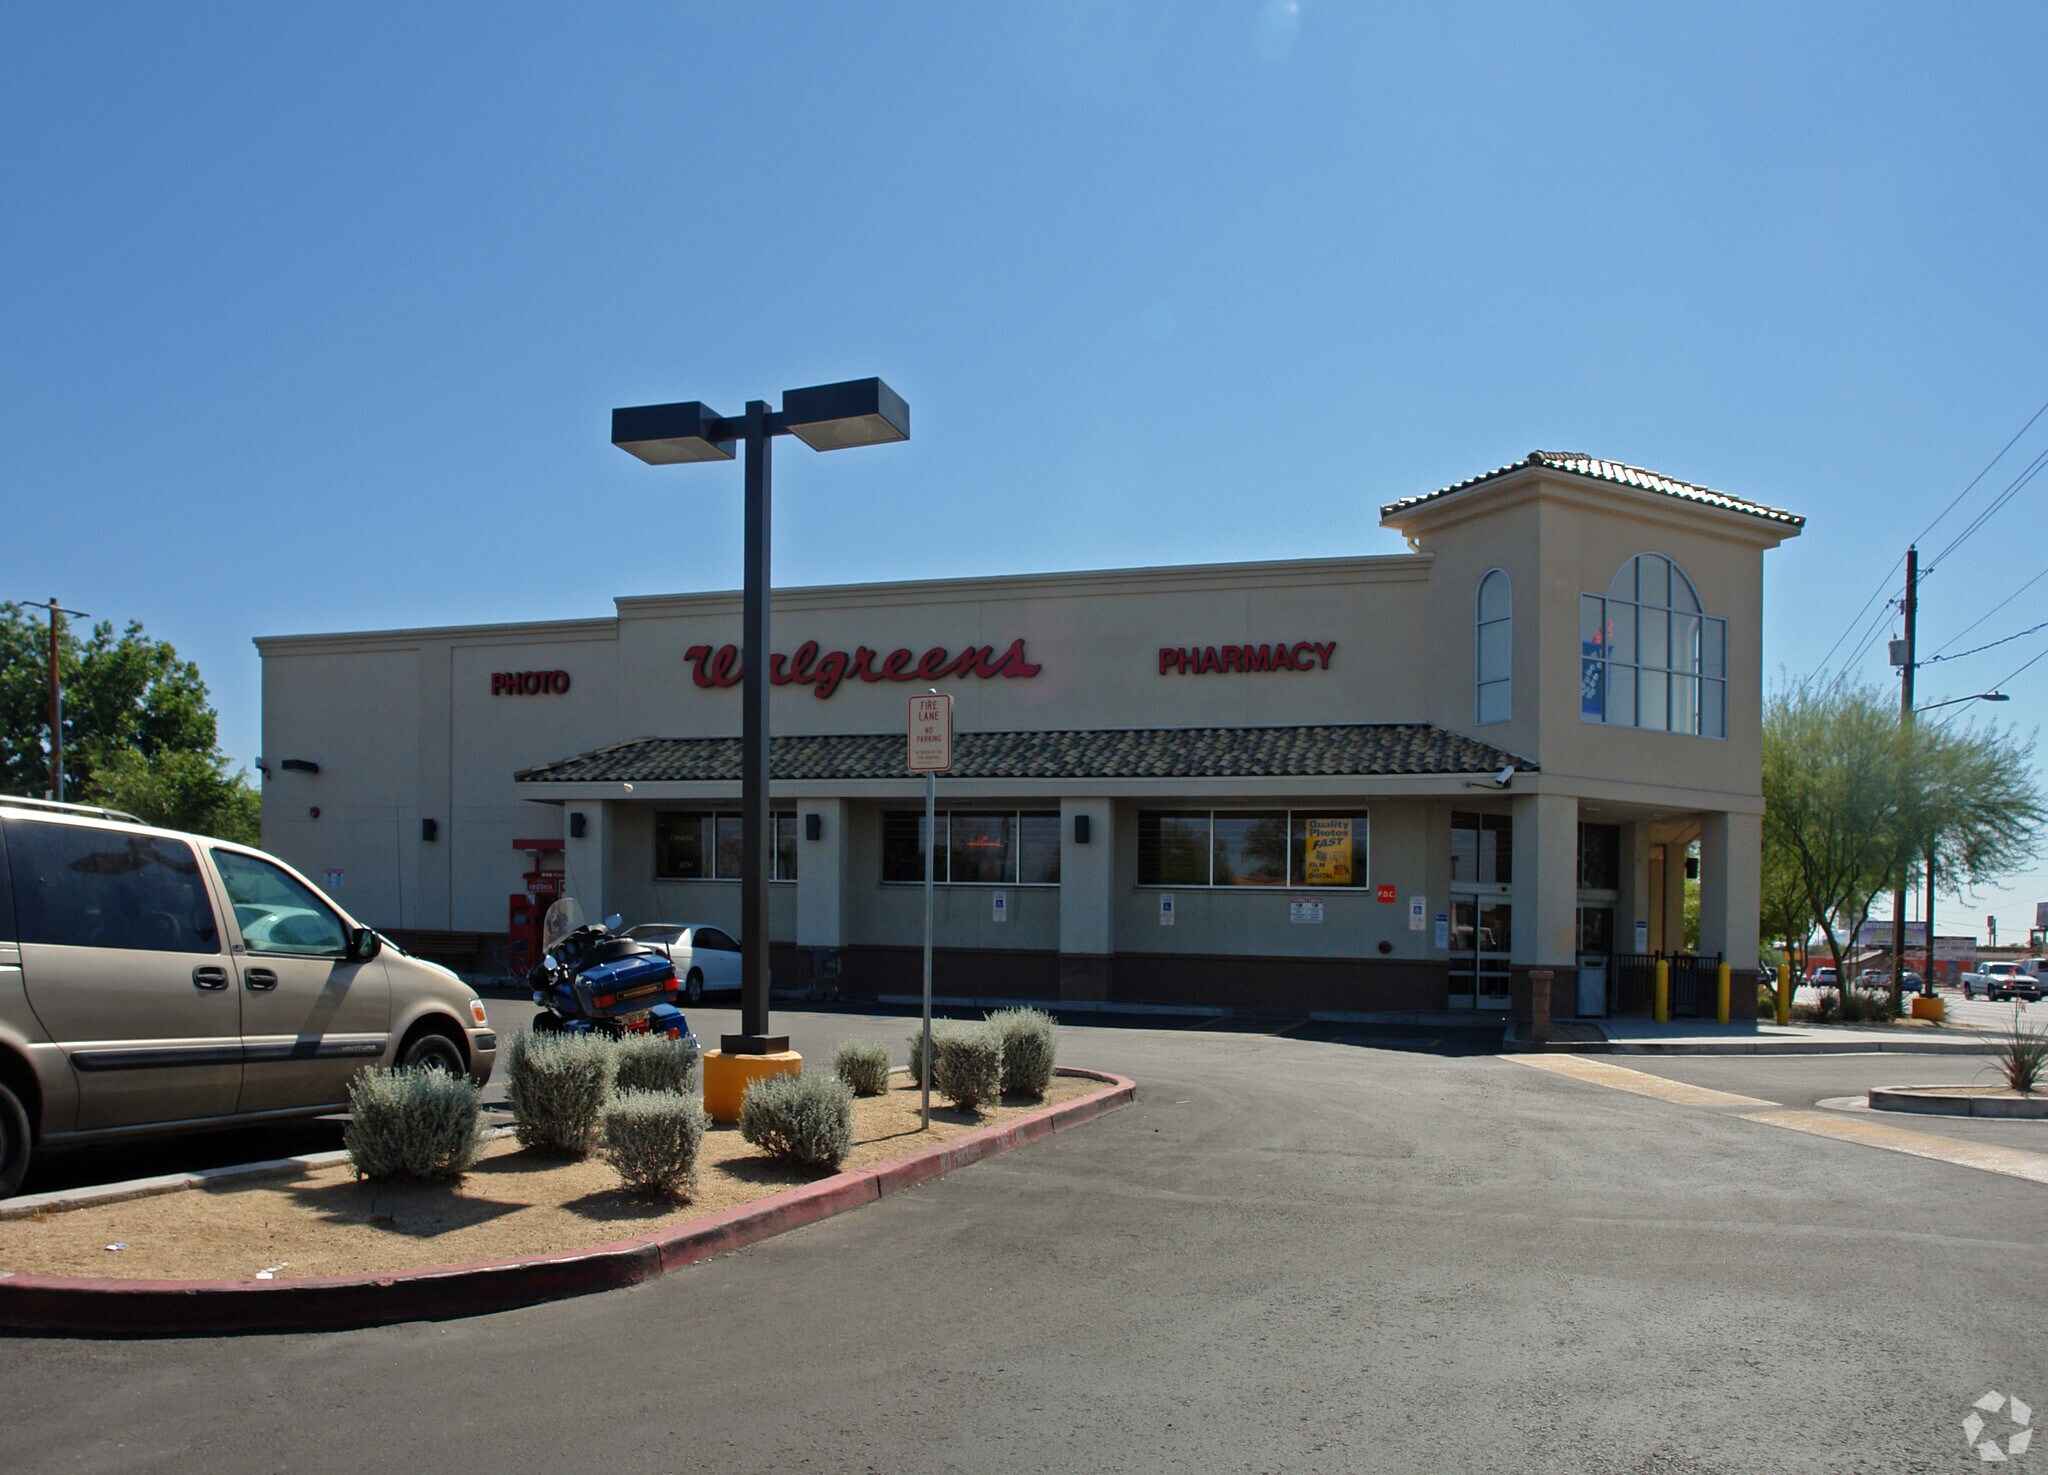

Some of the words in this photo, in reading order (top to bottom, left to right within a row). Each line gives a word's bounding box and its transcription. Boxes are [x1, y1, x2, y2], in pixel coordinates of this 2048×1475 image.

[1159, 641, 1337, 675] PHARMACY
[491, 670, 571, 696] PHOTO
[920, 701, 937, 710] FIRE
[918, 711, 939, 721] LANE
[924, 727, 934, 735] NO
[916, 735, 942, 744] PARKING
[1309, 820, 1349, 830] Quality
[1309, 828, 1349, 837] Photos
[1312, 837, 1344, 851] FAST
[529, 882, 553, 890] redbox
